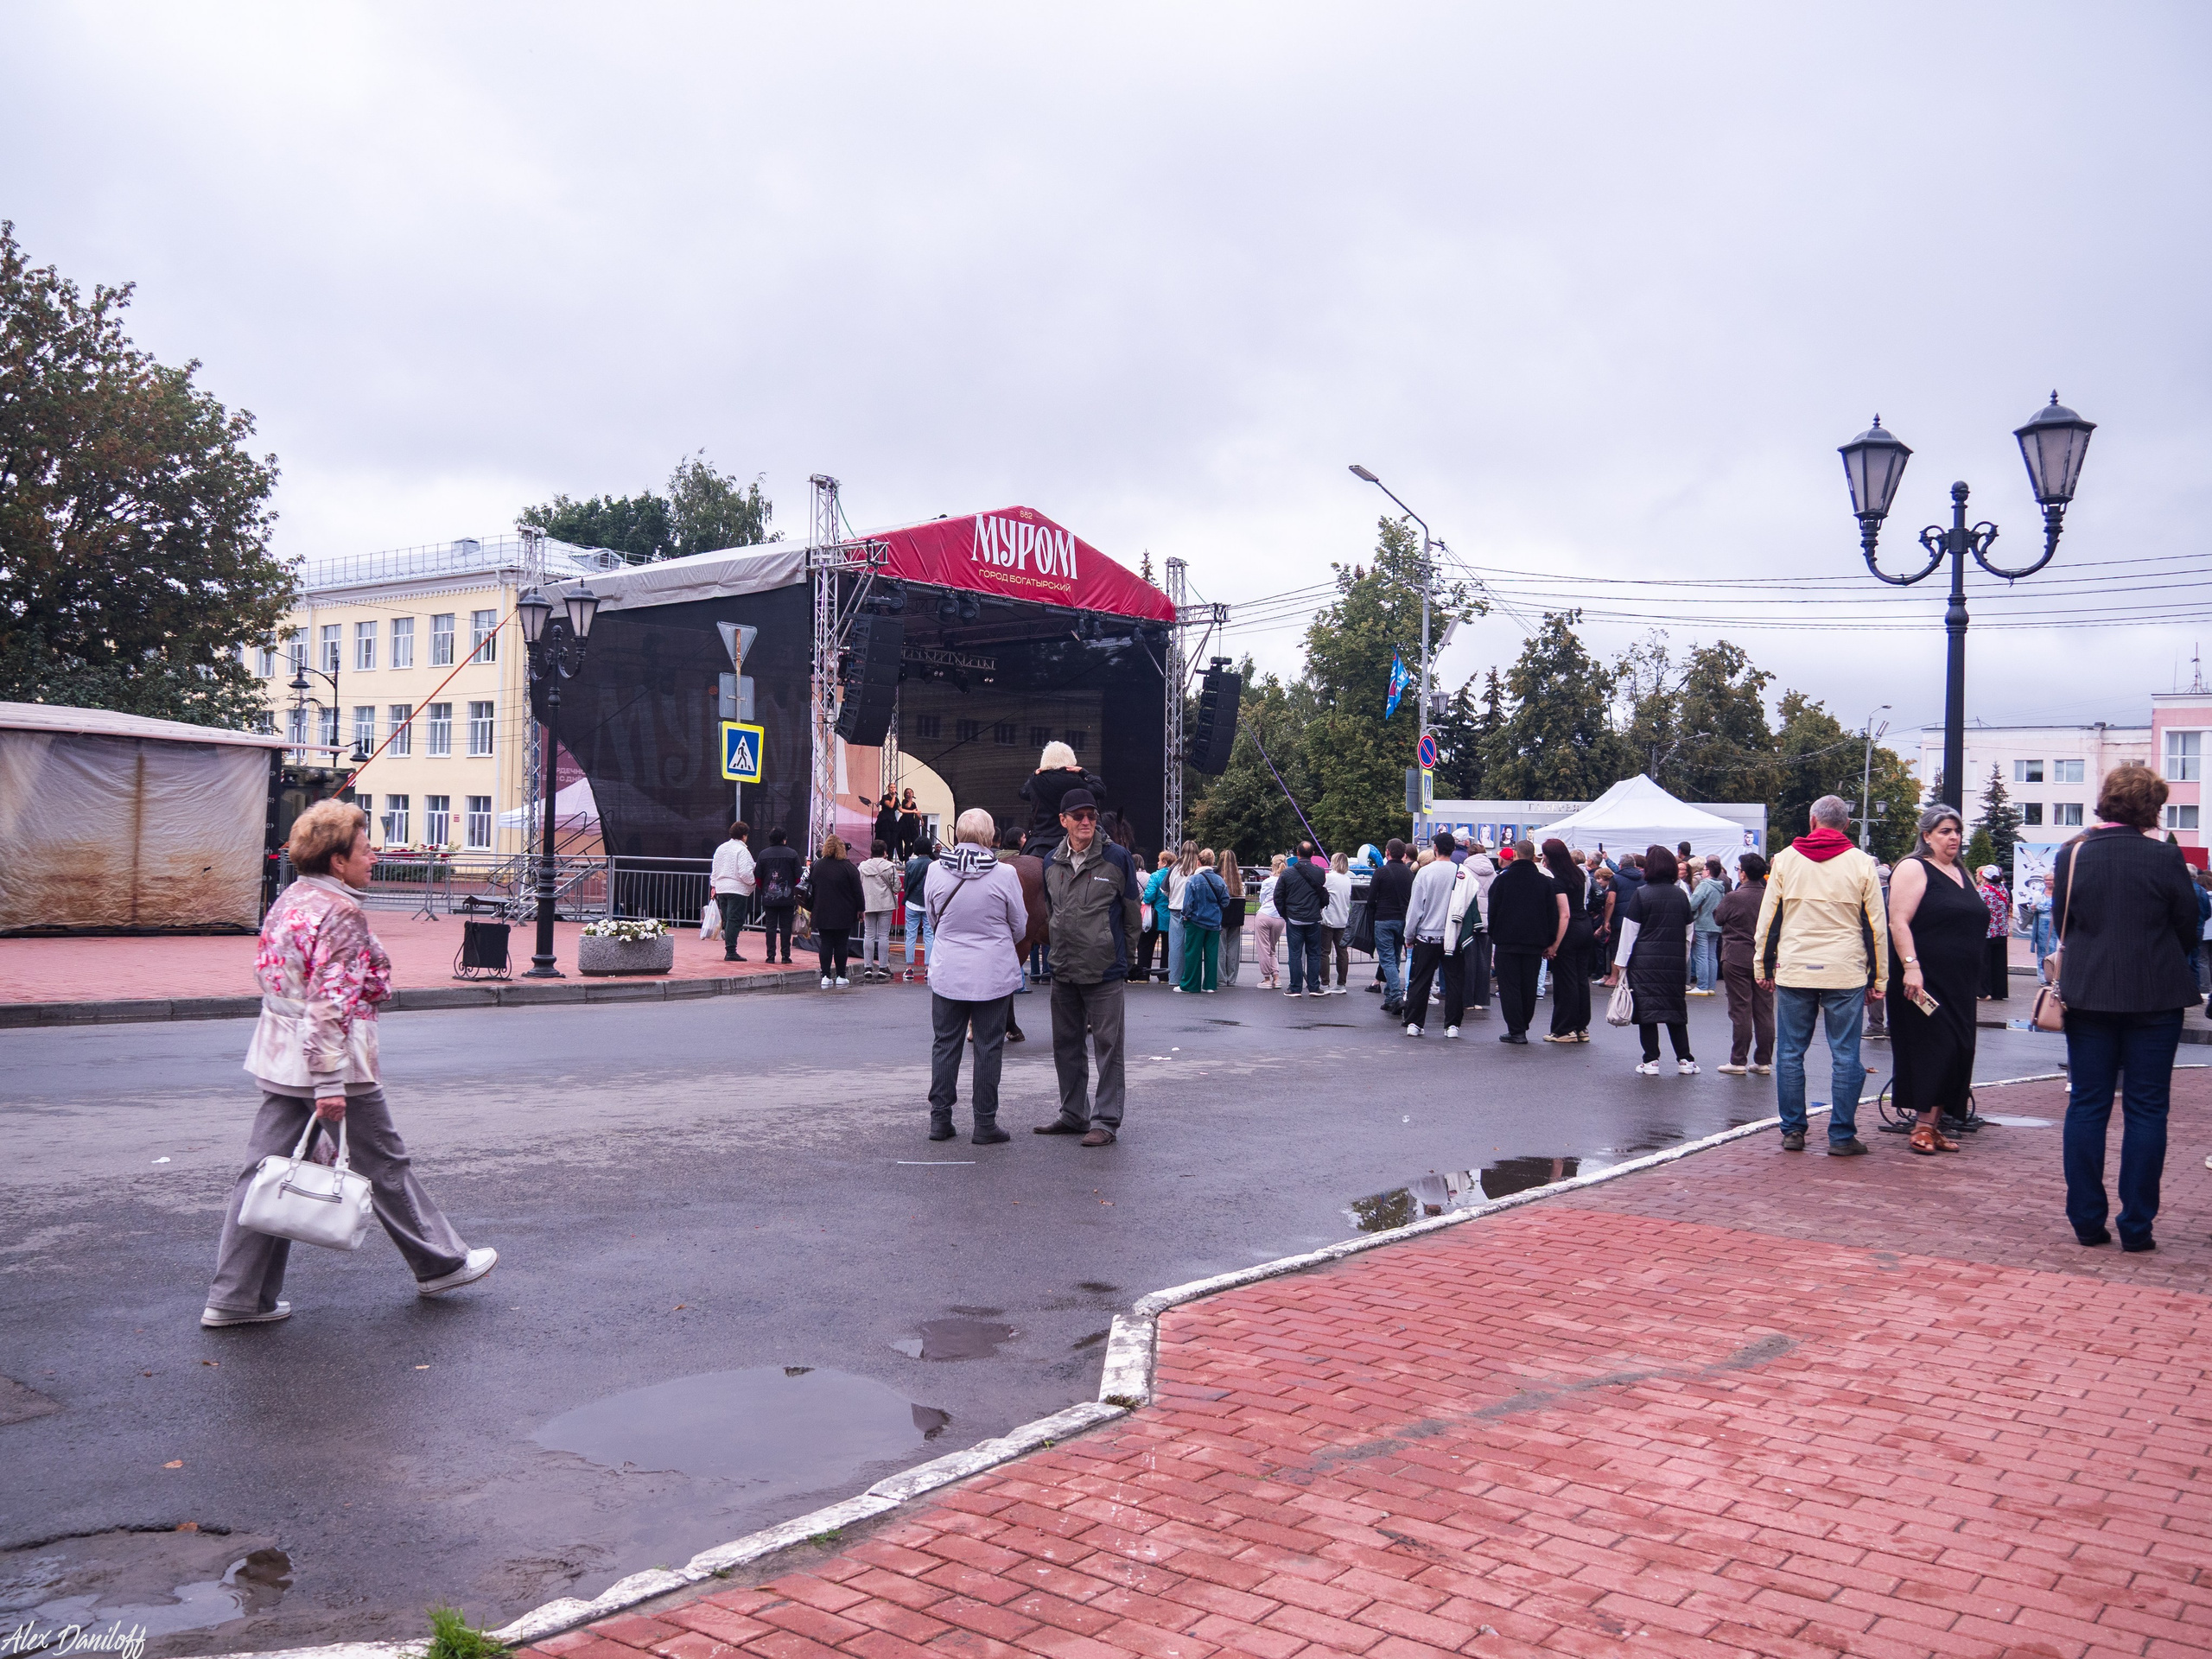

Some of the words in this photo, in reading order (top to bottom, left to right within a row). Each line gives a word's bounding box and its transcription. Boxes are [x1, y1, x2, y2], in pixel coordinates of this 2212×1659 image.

[1020, 510, 1033, 519] 862
[971, 514, 1078, 580] МУРОМ
[979, 569, 1008, 582] ГОРОД
[1009, 575, 1071, 592] БОГАТЫРСКИЙ
